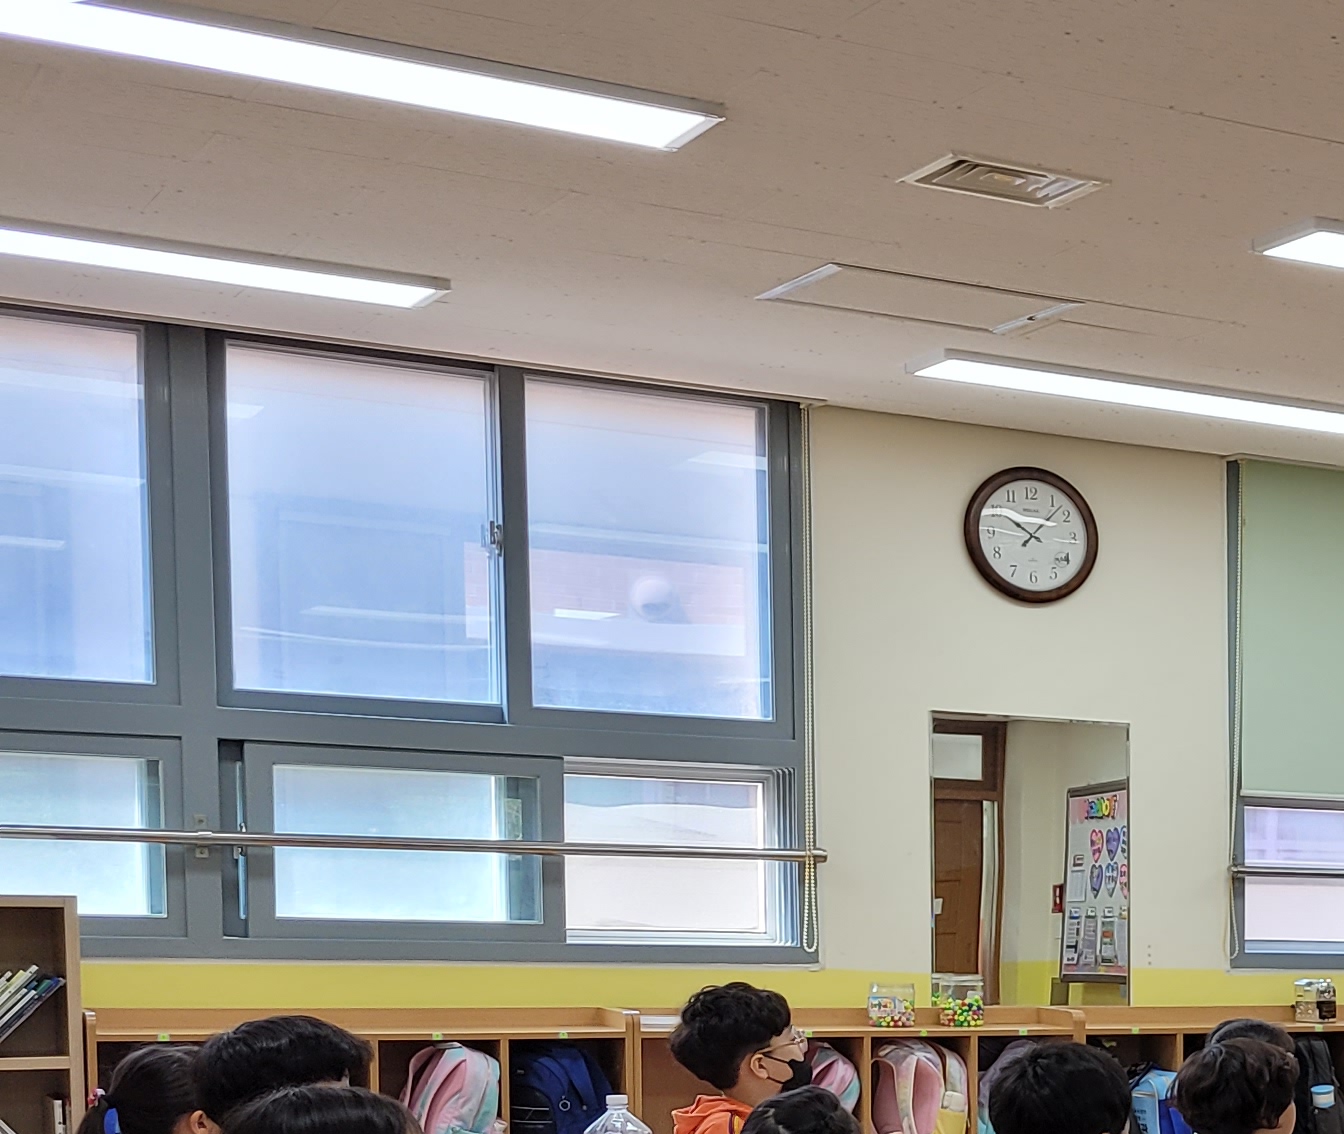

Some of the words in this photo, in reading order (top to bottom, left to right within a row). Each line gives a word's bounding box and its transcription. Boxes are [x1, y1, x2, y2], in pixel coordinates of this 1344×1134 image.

[1006, 489, 1016, 503] 11
[1024, 486, 1038, 500] 12
[1050, 494, 1055, 507] 1
[1062, 510, 1071, 523] 2
[986, 526, 996, 539] 9
[1069, 532, 1077, 544] 3
[993, 546, 1001, 559] 8
[1009, 565, 1018, 577] 7
[1029, 570, 1038, 583] 6
[1049, 567, 1057, 580] 5
